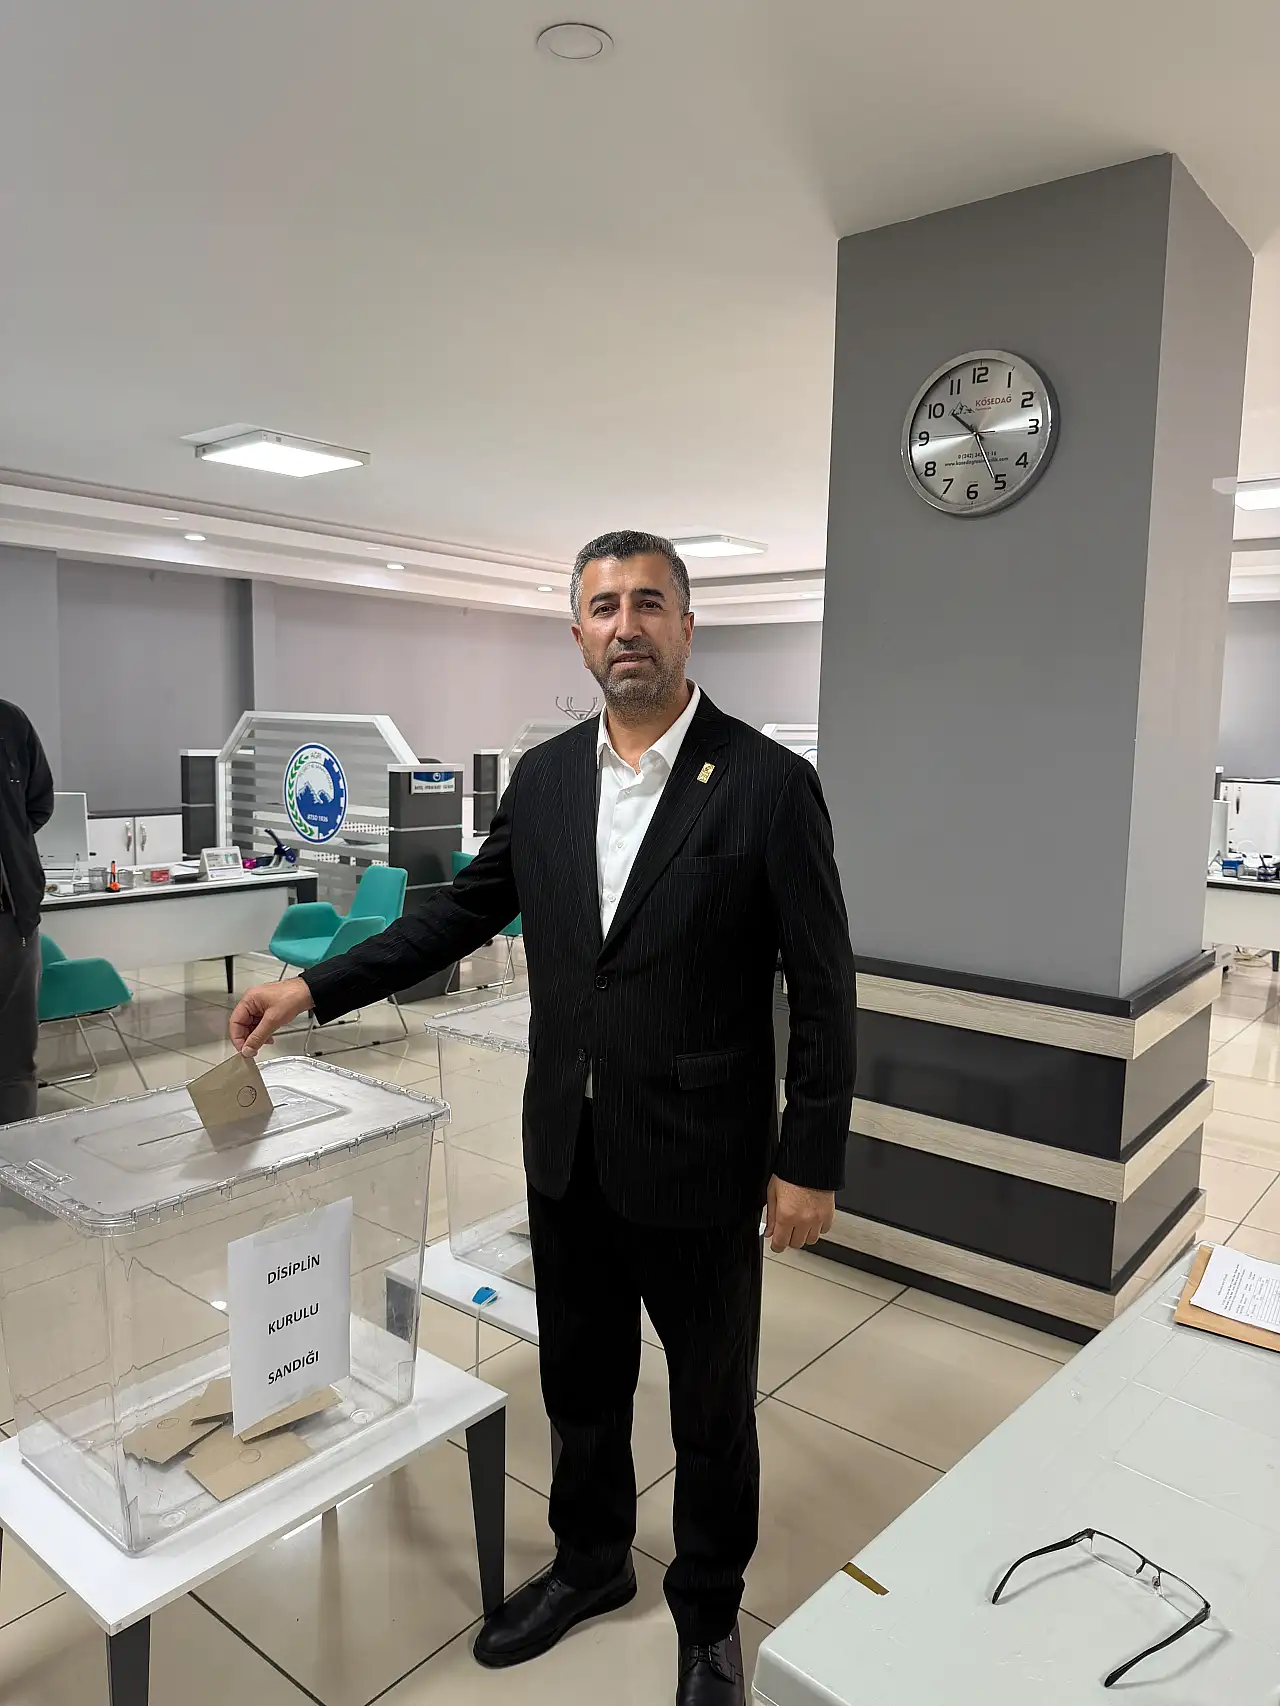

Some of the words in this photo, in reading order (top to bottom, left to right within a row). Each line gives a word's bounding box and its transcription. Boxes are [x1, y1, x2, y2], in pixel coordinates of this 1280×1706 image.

[971, 366, 990, 384] 12
[1007, 371, 1013, 388] 1
[949, 379, 961, 395] 11
[975, 394, 1012, 407] KÖSEDAĞ
[1021, 391, 1035, 408] 2
[928, 402, 945, 419] 10
[1027, 419, 1040, 435] 3
[918, 431, 930, 446] 9
[1015, 452, 1029, 468] 4
[924, 461, 937, 477] 8
[942, 478, 954, 494] 7
[994, 473, 1007, 490] 5
[966, 484, 979, 500] 6
[267, 1254, 320, 1285] DİSİPLİN
[268, 1302, 319, 1335] KURULU
[268, 1350, 320, 1385] SANDIĞI
